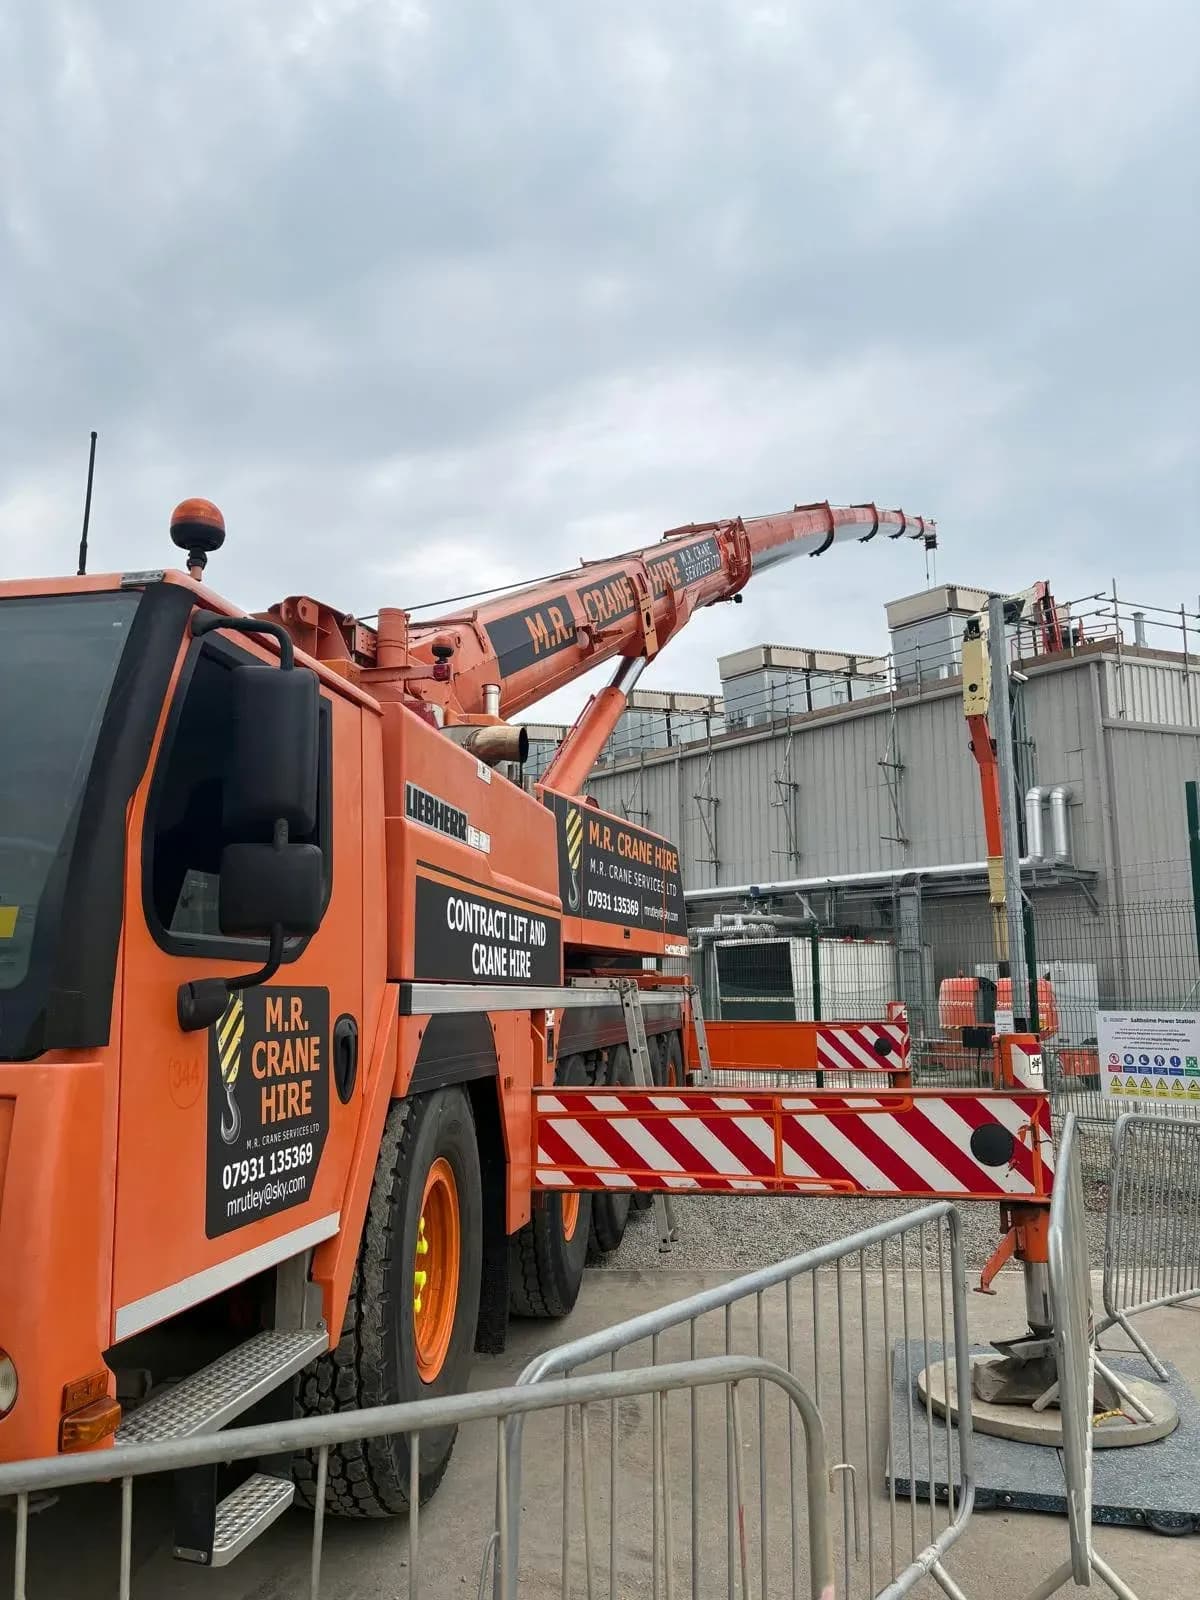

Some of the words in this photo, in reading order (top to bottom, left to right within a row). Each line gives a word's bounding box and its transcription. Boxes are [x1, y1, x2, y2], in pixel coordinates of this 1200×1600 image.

[679, 550, 695, 567] M.R.
[693, 542, 713, 560] CRANE
[685, 558, 710, 582] SERVICES
[710, 554, 720, 571] LTD
[525, 607, 575, 655] M.R.
[583, 578, 634, 622] CRANE
[649, 557, 682, 595] HIRE
[406, 784, 467, 841] LIEBHERR
[589, 820, 614, 853] M.R.
[617, 832, 652, 865] CRANE
[655, 845, 678, 874] HIRE
[590, 858, 607, 876] M.R.
[608, 864, 633, 885] CRANE
[633, 872, 665, 894] SERVICES
[666, 882, 677, 897] LTD
[447, 896, 507, 940] CONTRACT
[508, 914, 529, 944] LIFT
[529, 921, 547, 947] AND
[587, 889, 612, 910] 07931
[613, 895, 639, 916] 135369
[472, 943, 508, 977] CRANE
[509, 950, 532, 978] HIRE
[265, 996, 309, 1033] M.R.
[251, 1036, 320, 1080] CRANE
[261, 1079, 313, 1125] HIRE
[246, 1136, 261, 1150] M.R.
[261, 1131, 282, 1146] CRANE
[282, 1125, 310, 1142] SERVICES
[310, 1122, 320, 1134] LTD
[222, 1155, 266, 1190] 07931
[269, 1142, 313, 1176] 135369
[227, 1174, 306, 1217] mrutley@sky.com
